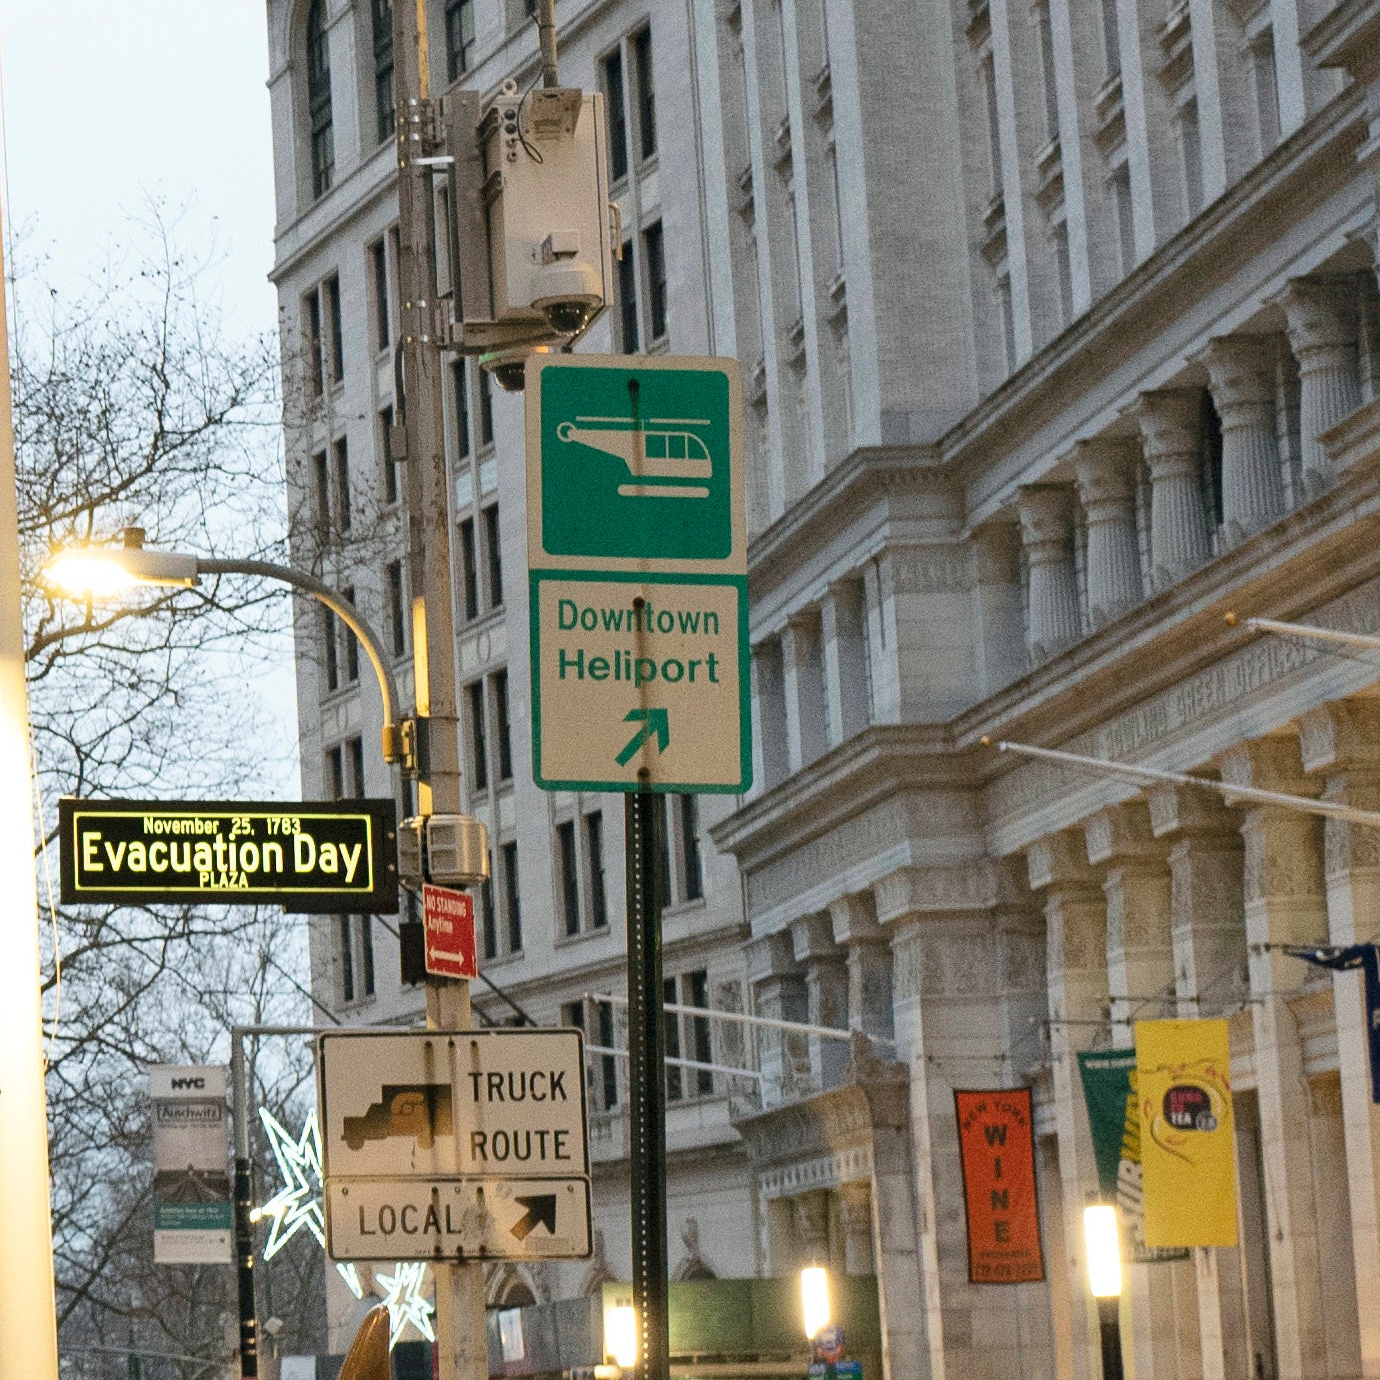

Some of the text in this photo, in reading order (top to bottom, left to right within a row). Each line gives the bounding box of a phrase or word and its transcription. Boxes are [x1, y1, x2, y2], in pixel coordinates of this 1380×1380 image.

[557, 598, 720, 636] Downtown
[558, 648, 720, 689] Heliport
[143, 816, 302, 837] November 25, 1783
[82, 831, 363, 884] Evacuation Day
[199, 871, 249, 889] PLAZA
[426, 894, 467, 918] NO STANDING
[428, 913, 454, 935] Anytime
[170, 1077, 206, 1091] NYC
[467, 1070, 568, 1103] TRUCK
[470, 1129, 571, 1162] ROUTE
[983, 1123, 1011, 1244] WINE
[358, 1203, 463, 1235] LOCAL
